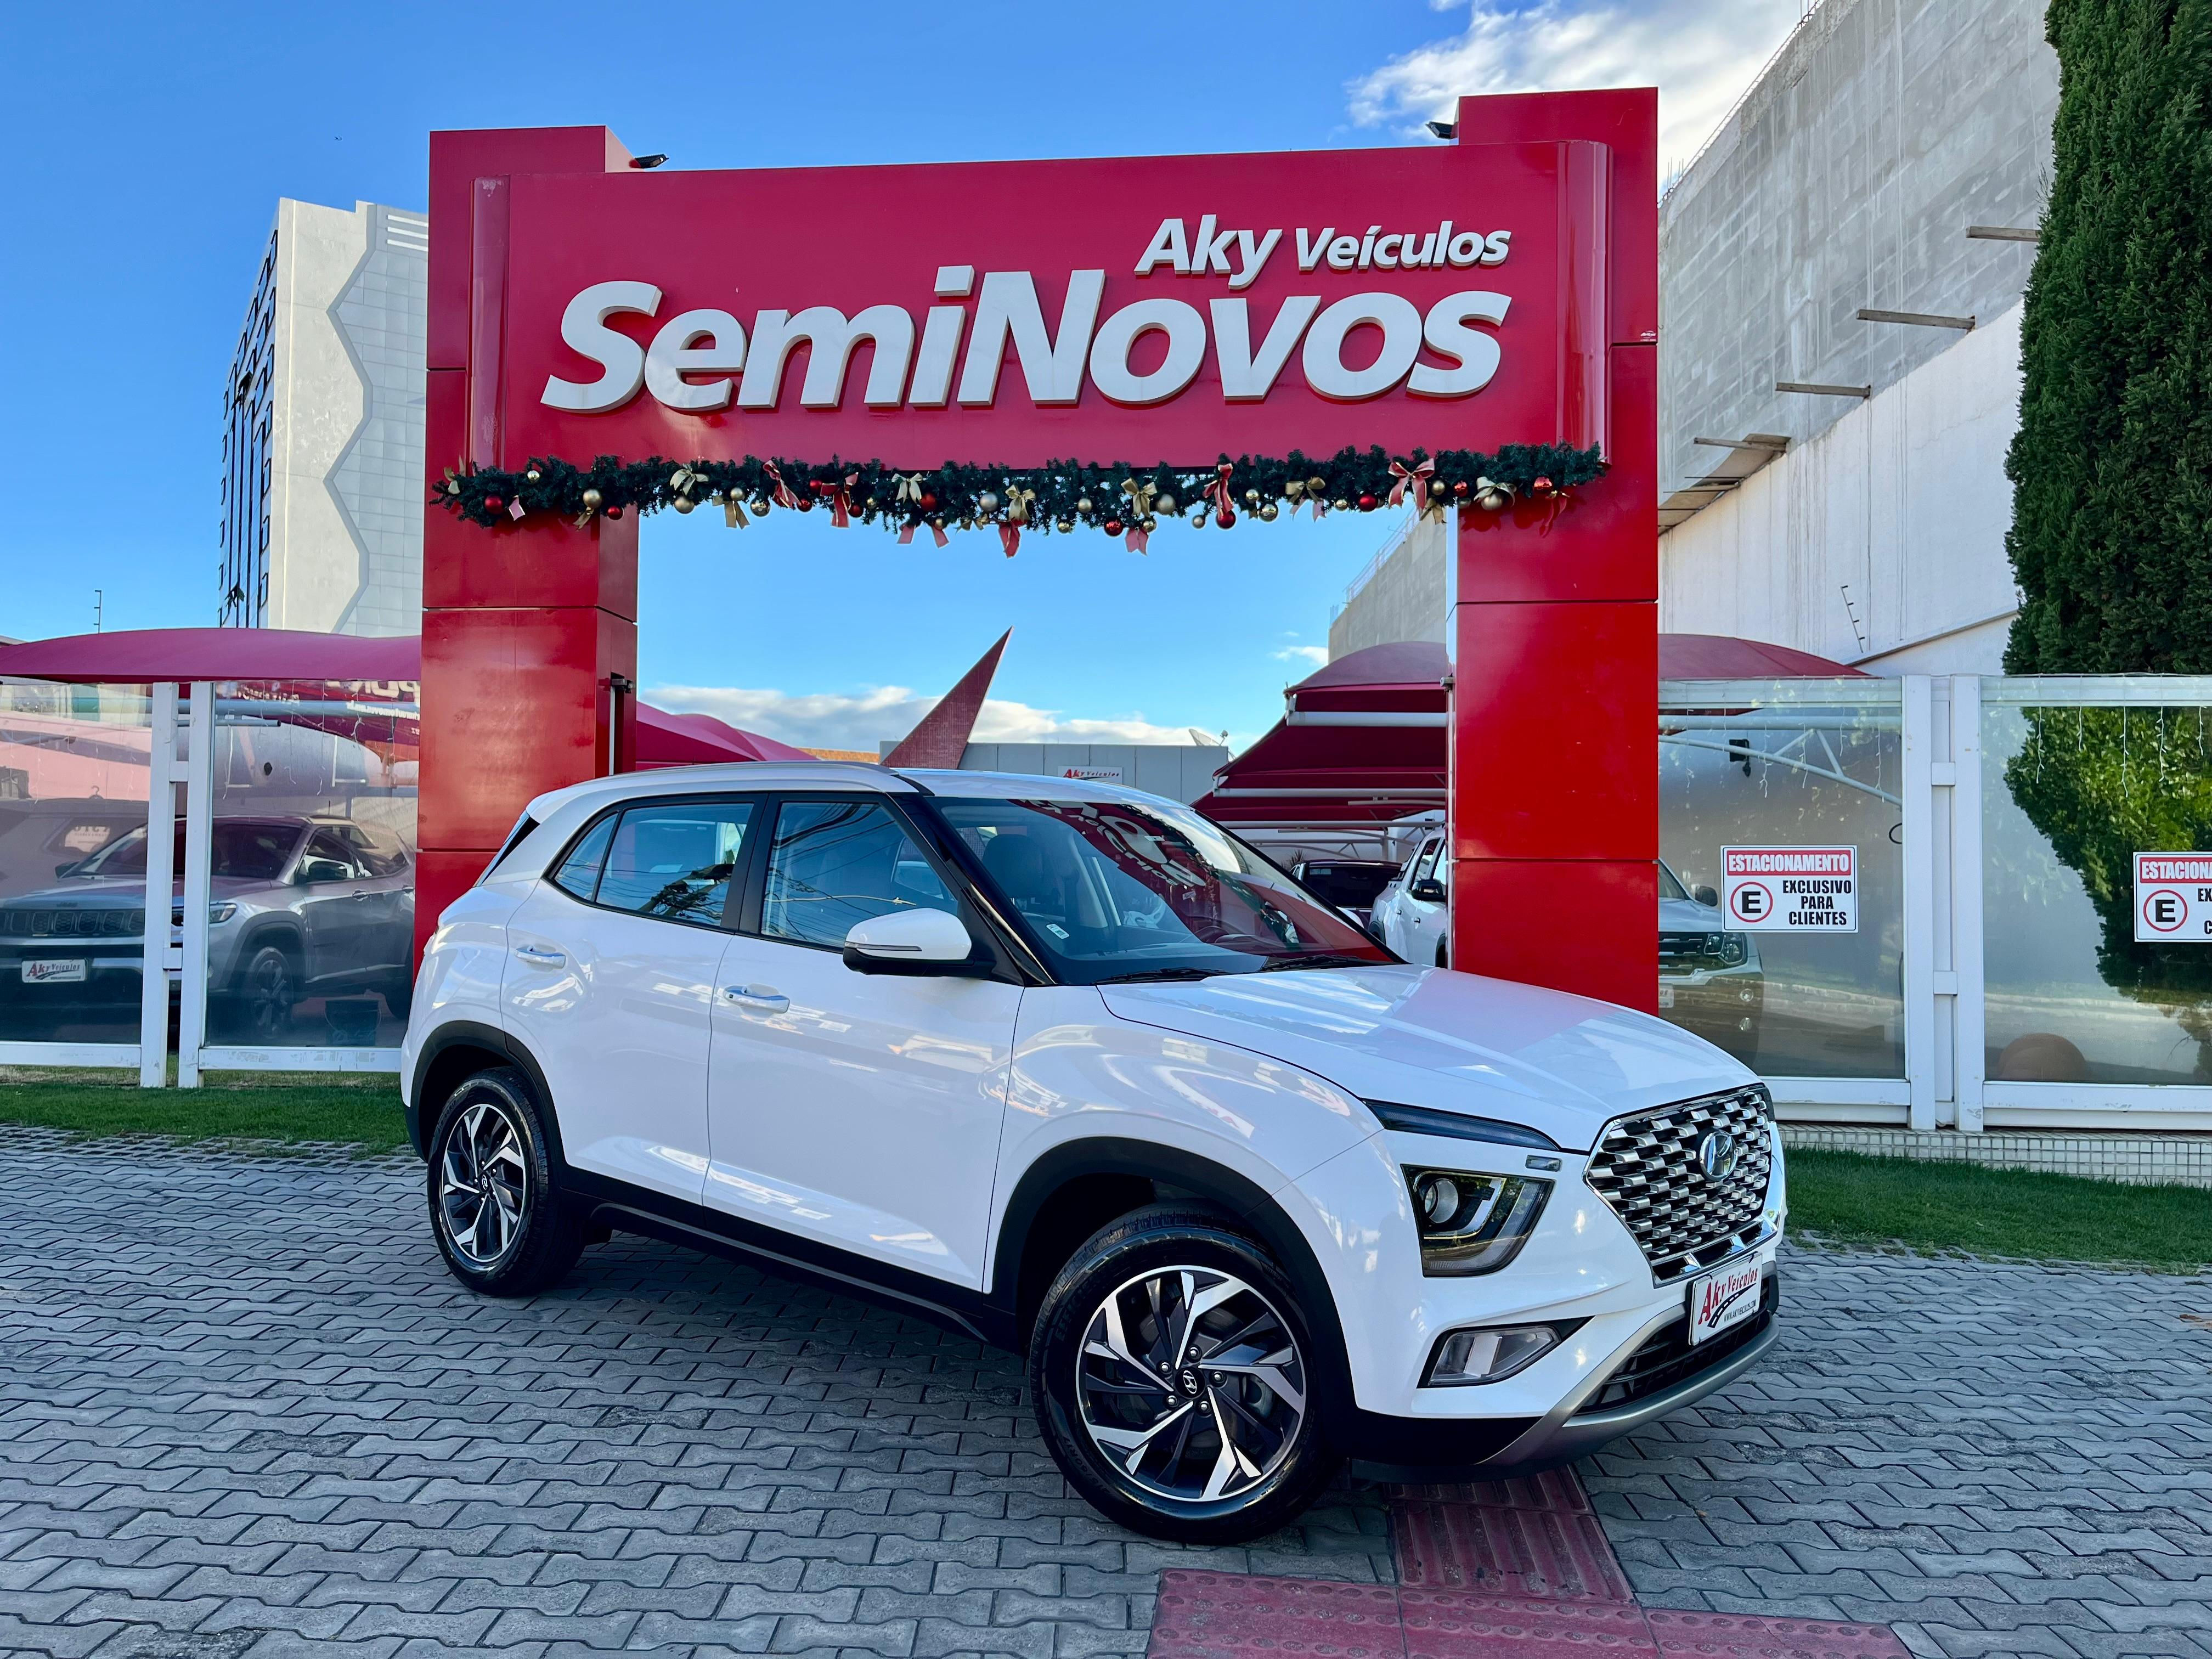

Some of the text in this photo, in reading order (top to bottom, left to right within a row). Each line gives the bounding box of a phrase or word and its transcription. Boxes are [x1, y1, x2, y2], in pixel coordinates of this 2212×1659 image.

[1133, 214, 1512, 290] Aky Veículos
[540, 265, 1512, 414] SemiNovos
[1729, 854, 1849, 872] ESTACIONAMENTO
[1782, 880, 1852, 894] EXCLUSIVO
[1741, 891, 1762, 913] E
[1801, 896, 1834, 909] PARA
[2155, 899, 2176, 922] E
[1788, 911, 1847, 925] CLIENTES
[26, 962, 51, 977] Aky
[1698, 1267, 1758, 1325] Aky Veículos
